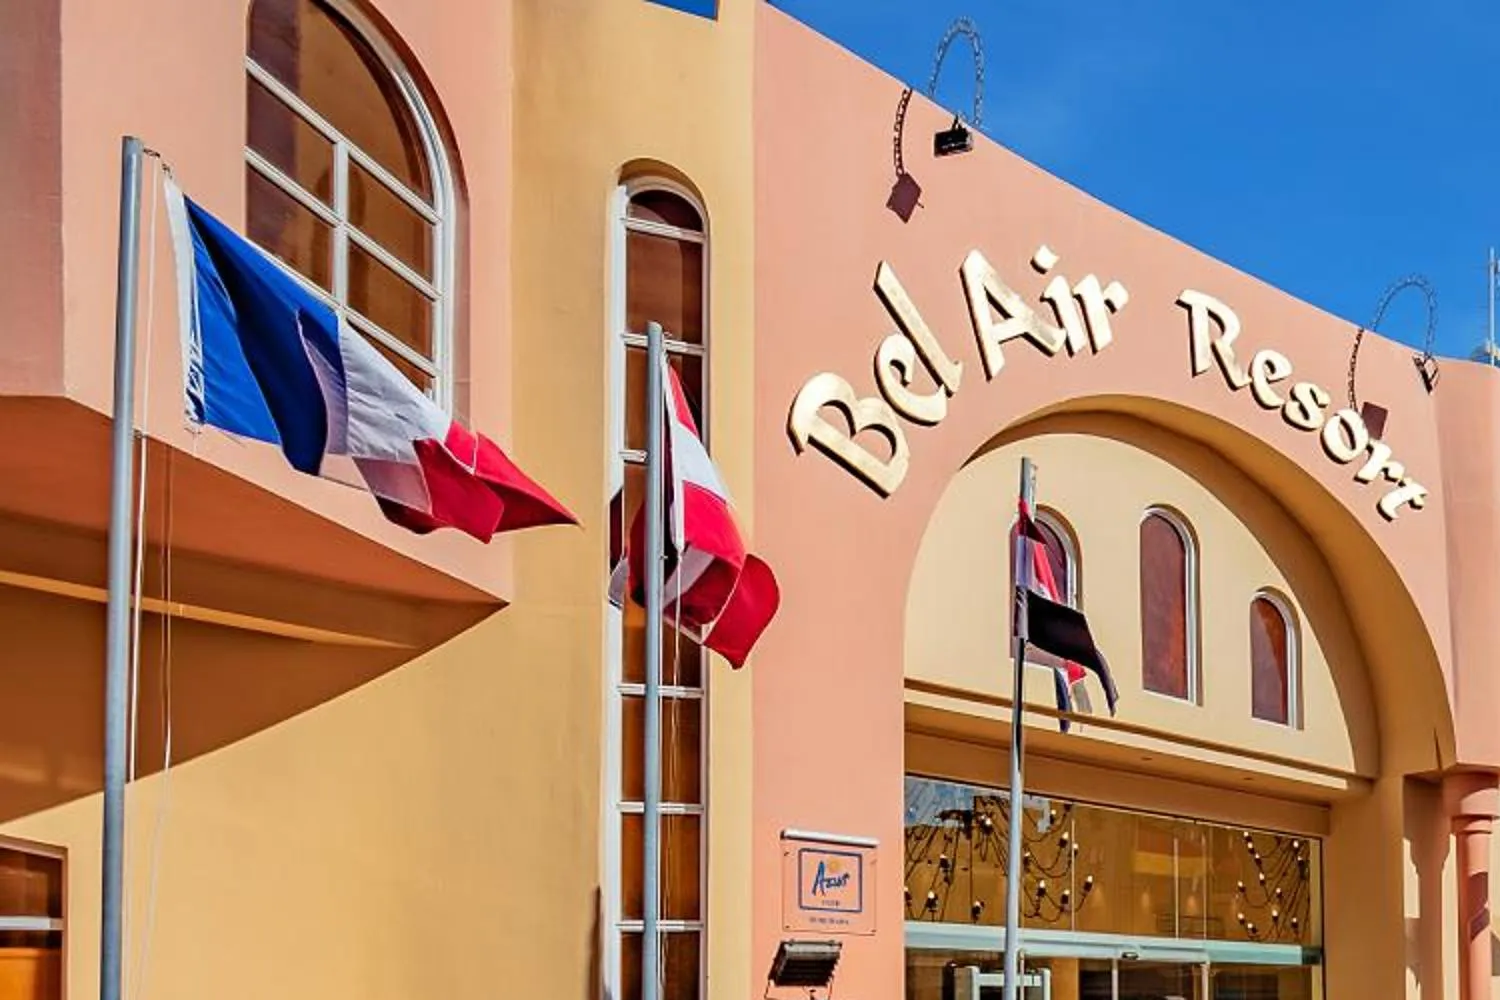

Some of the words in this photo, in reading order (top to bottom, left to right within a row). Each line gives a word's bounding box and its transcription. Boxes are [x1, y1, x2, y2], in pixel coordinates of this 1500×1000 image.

[786, 260, 962, 499] Bel
[960, 245, 1129, 382] Air
[1175, 289, 1427, 521] Resort
